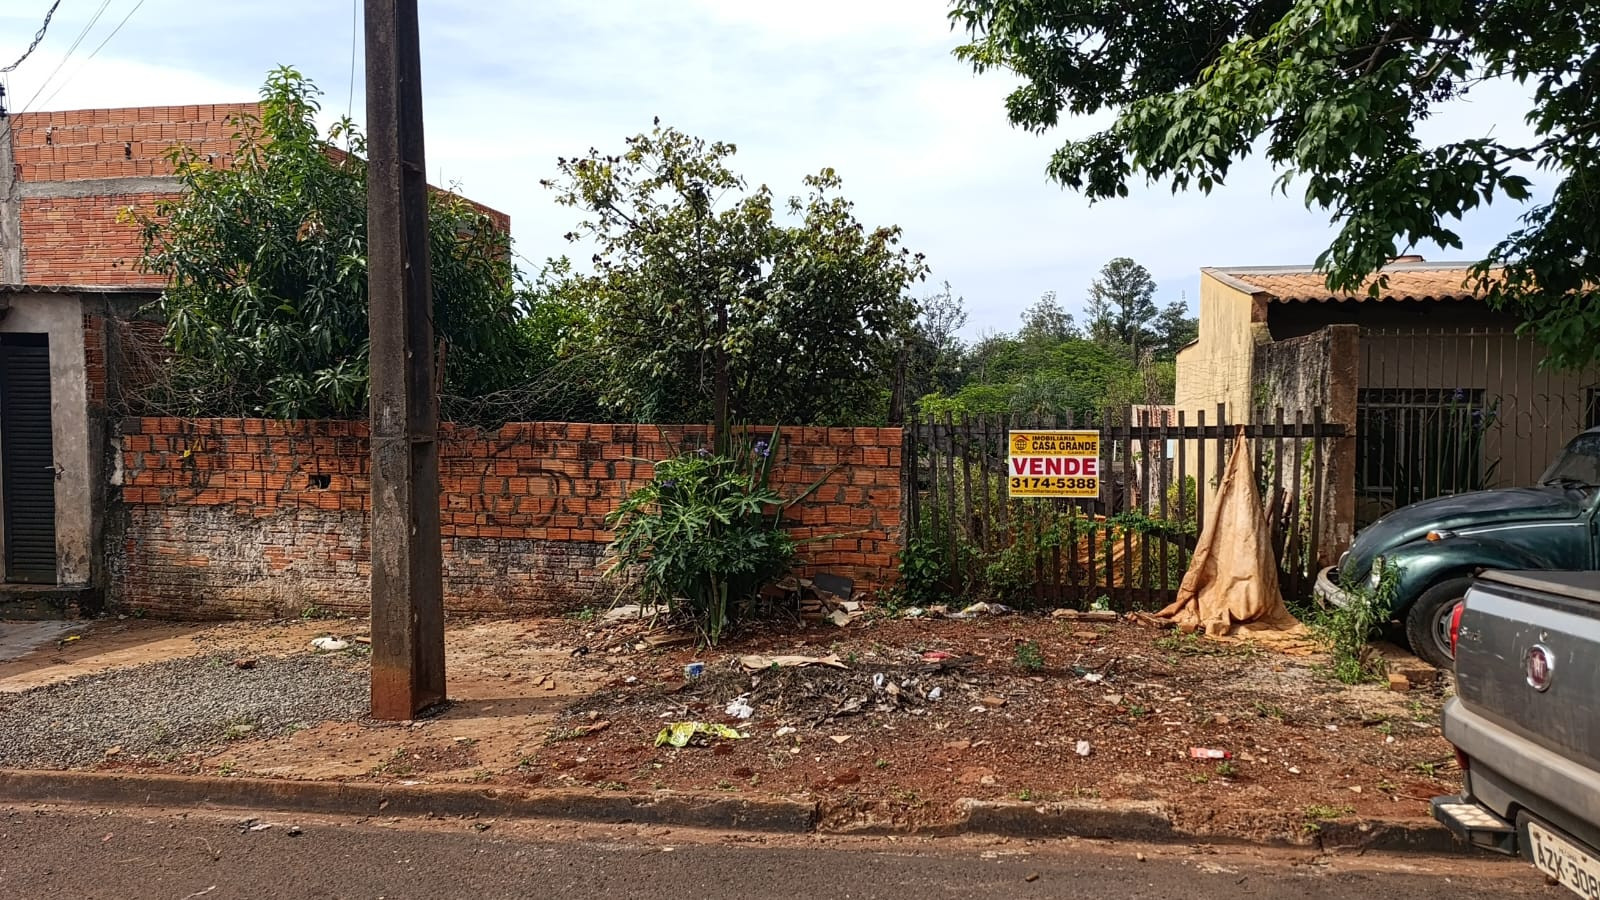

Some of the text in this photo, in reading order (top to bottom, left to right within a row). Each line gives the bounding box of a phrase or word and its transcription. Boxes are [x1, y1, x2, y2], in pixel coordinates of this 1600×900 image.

[1032, 441, 1097, 451] CASA GRANDE
[1012, 457, 1097, 475] VENDE
[1011, 477, 1096, 489] 3174-5388
[1537, 842, 1600, 900] AZK-308
